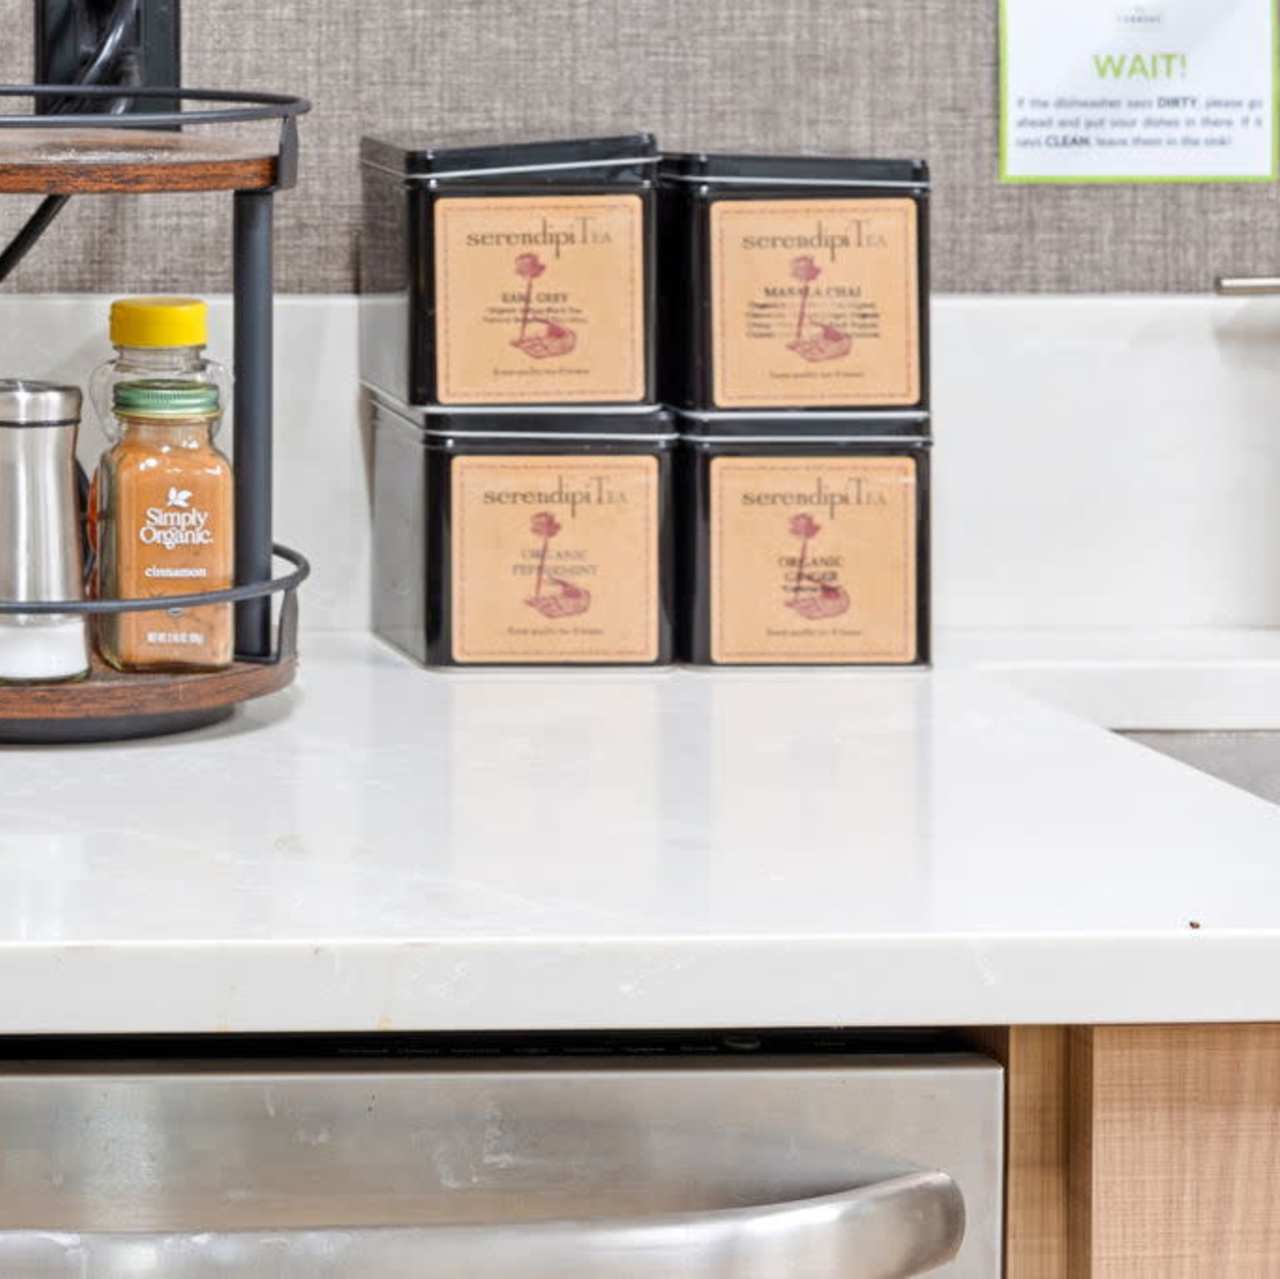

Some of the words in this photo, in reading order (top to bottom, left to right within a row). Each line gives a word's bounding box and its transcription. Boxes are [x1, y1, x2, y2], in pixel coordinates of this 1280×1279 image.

[1092, 53, 1188, 80] WAIT!
[145, 506, 209, 530] Simply
[784, 571, 838, 582] GNGER
